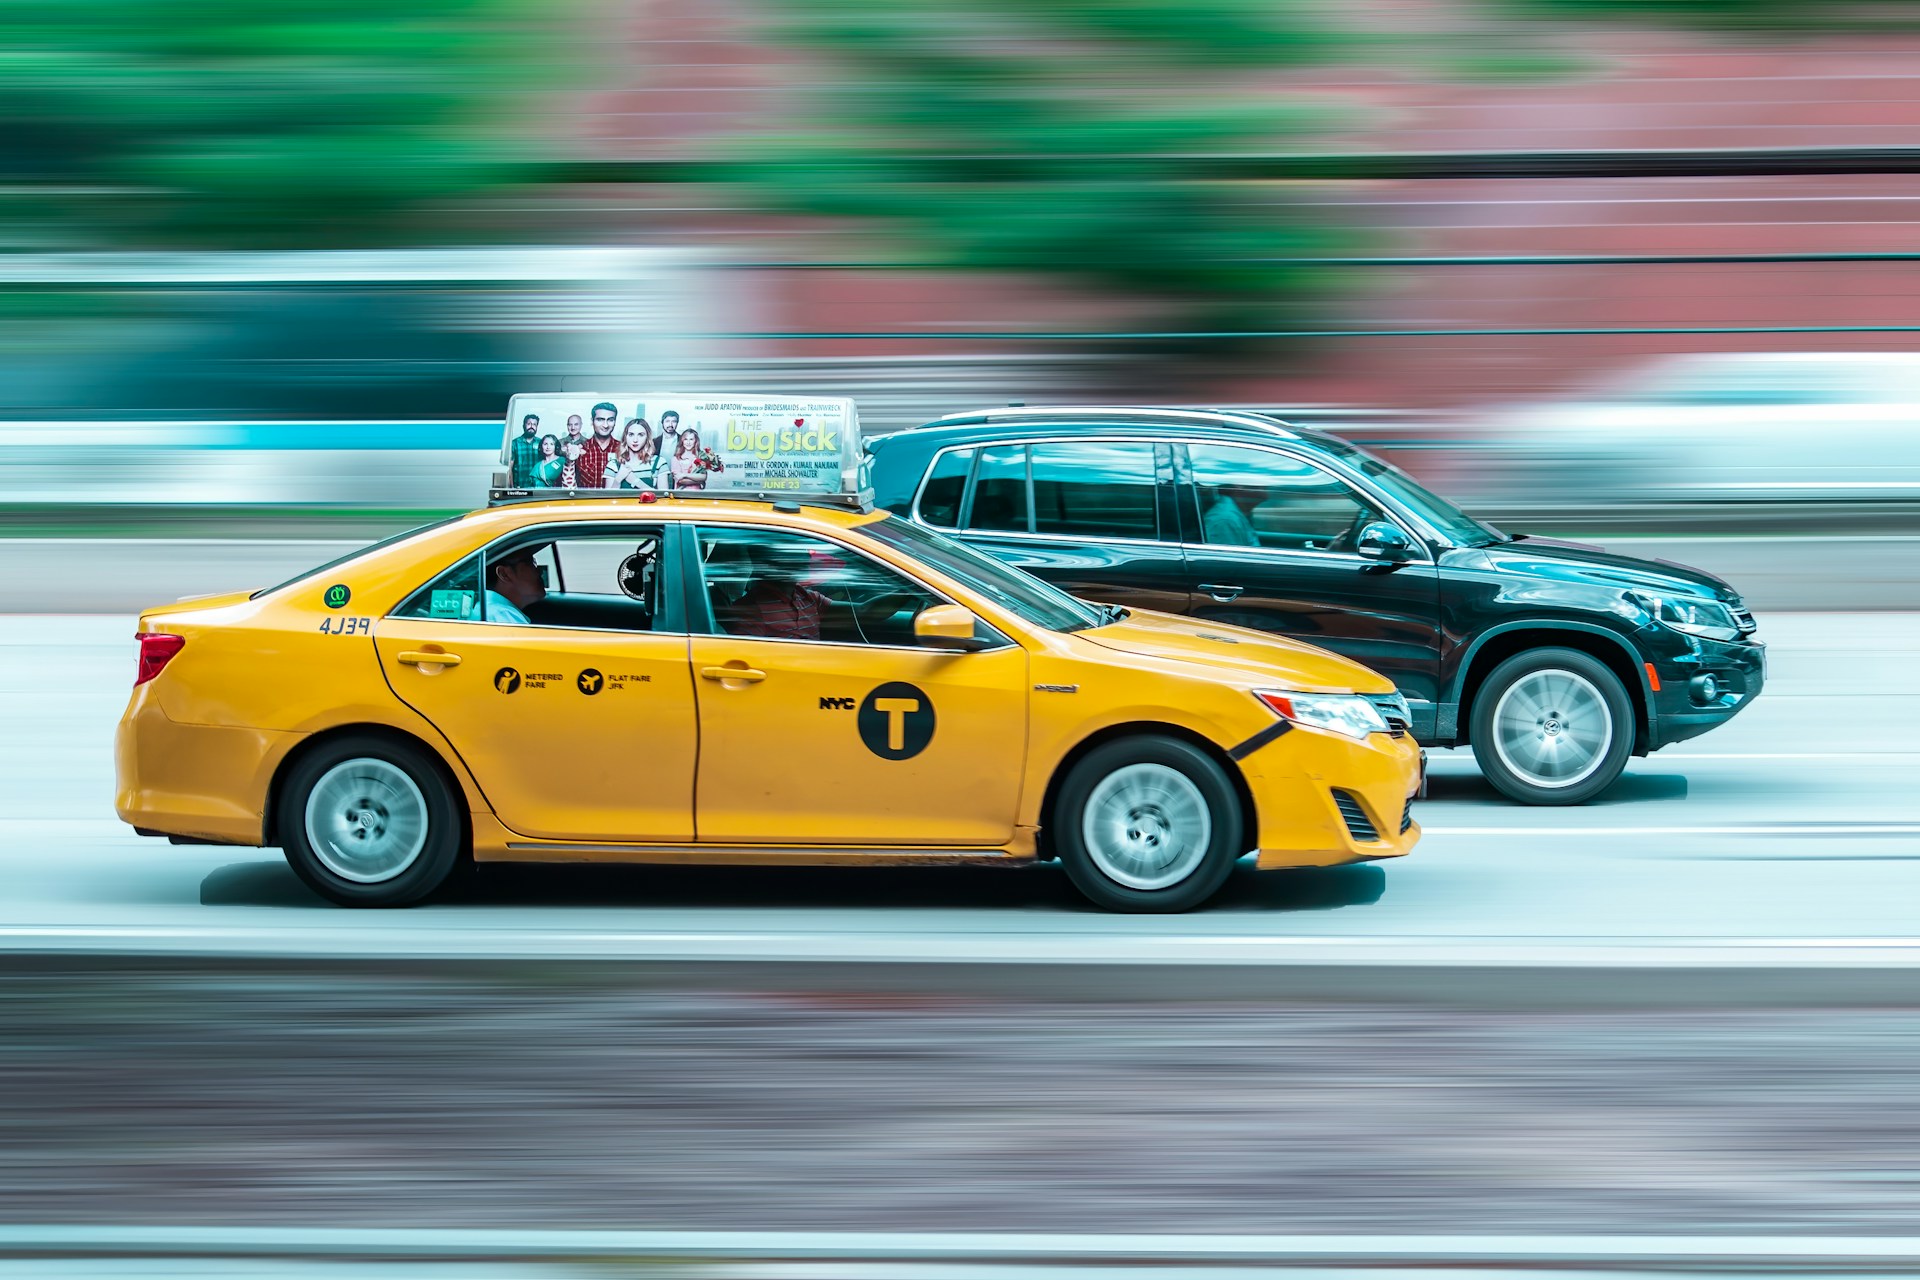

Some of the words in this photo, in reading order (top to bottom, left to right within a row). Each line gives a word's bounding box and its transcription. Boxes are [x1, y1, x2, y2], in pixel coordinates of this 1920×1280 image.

[741, 420, 762, 430] THE
[728, 419, 776, 460] big
[780, 418, 837, 452] sick
[765, 470, 786, 478] MICHAEL
[788, 470, 818, 478] SHOWALTER
[319, 617, 370, 635] 4J39
[820, 698, 856, 710] NYC
[874, 698, 920, 750] T
